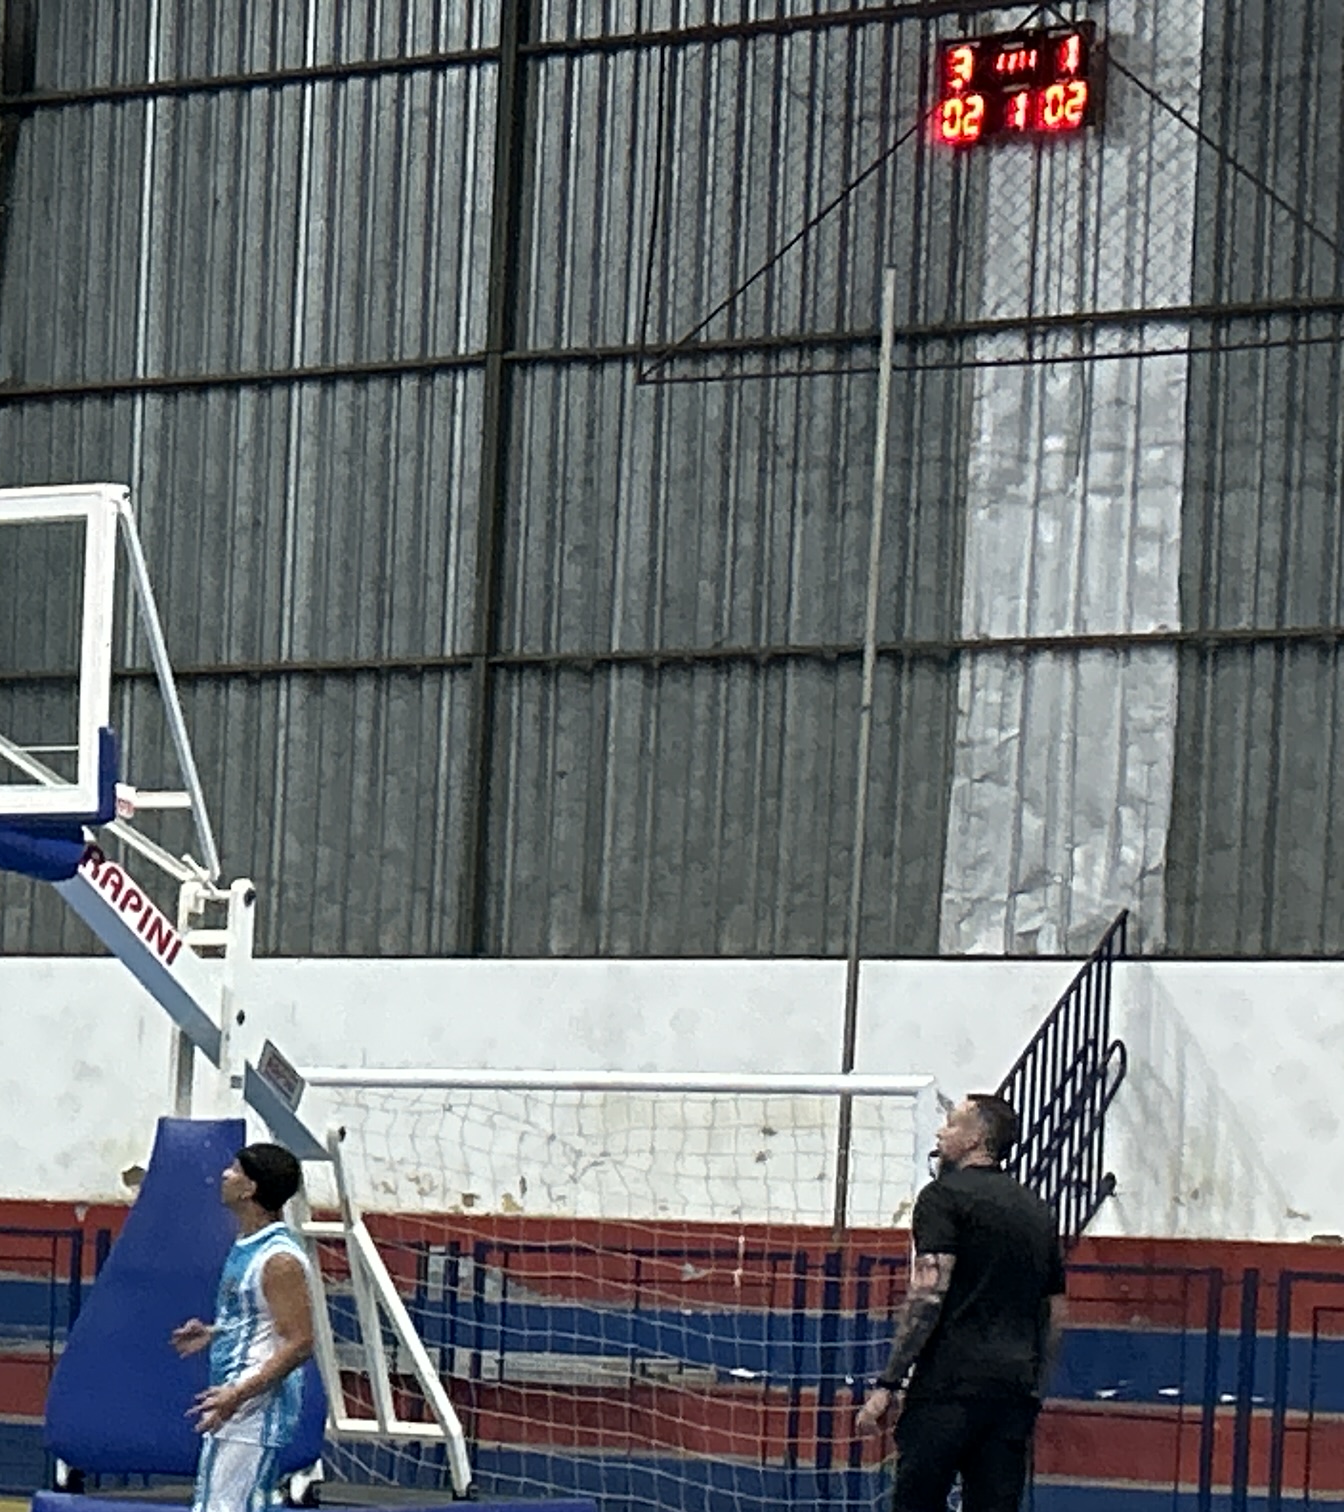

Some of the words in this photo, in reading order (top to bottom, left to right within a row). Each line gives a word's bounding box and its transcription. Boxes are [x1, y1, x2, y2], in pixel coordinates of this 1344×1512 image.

[949, 46, 973, 89] 3
[942, 93, 984, 139] 02
[1043, 80, 1087, 126] 02
